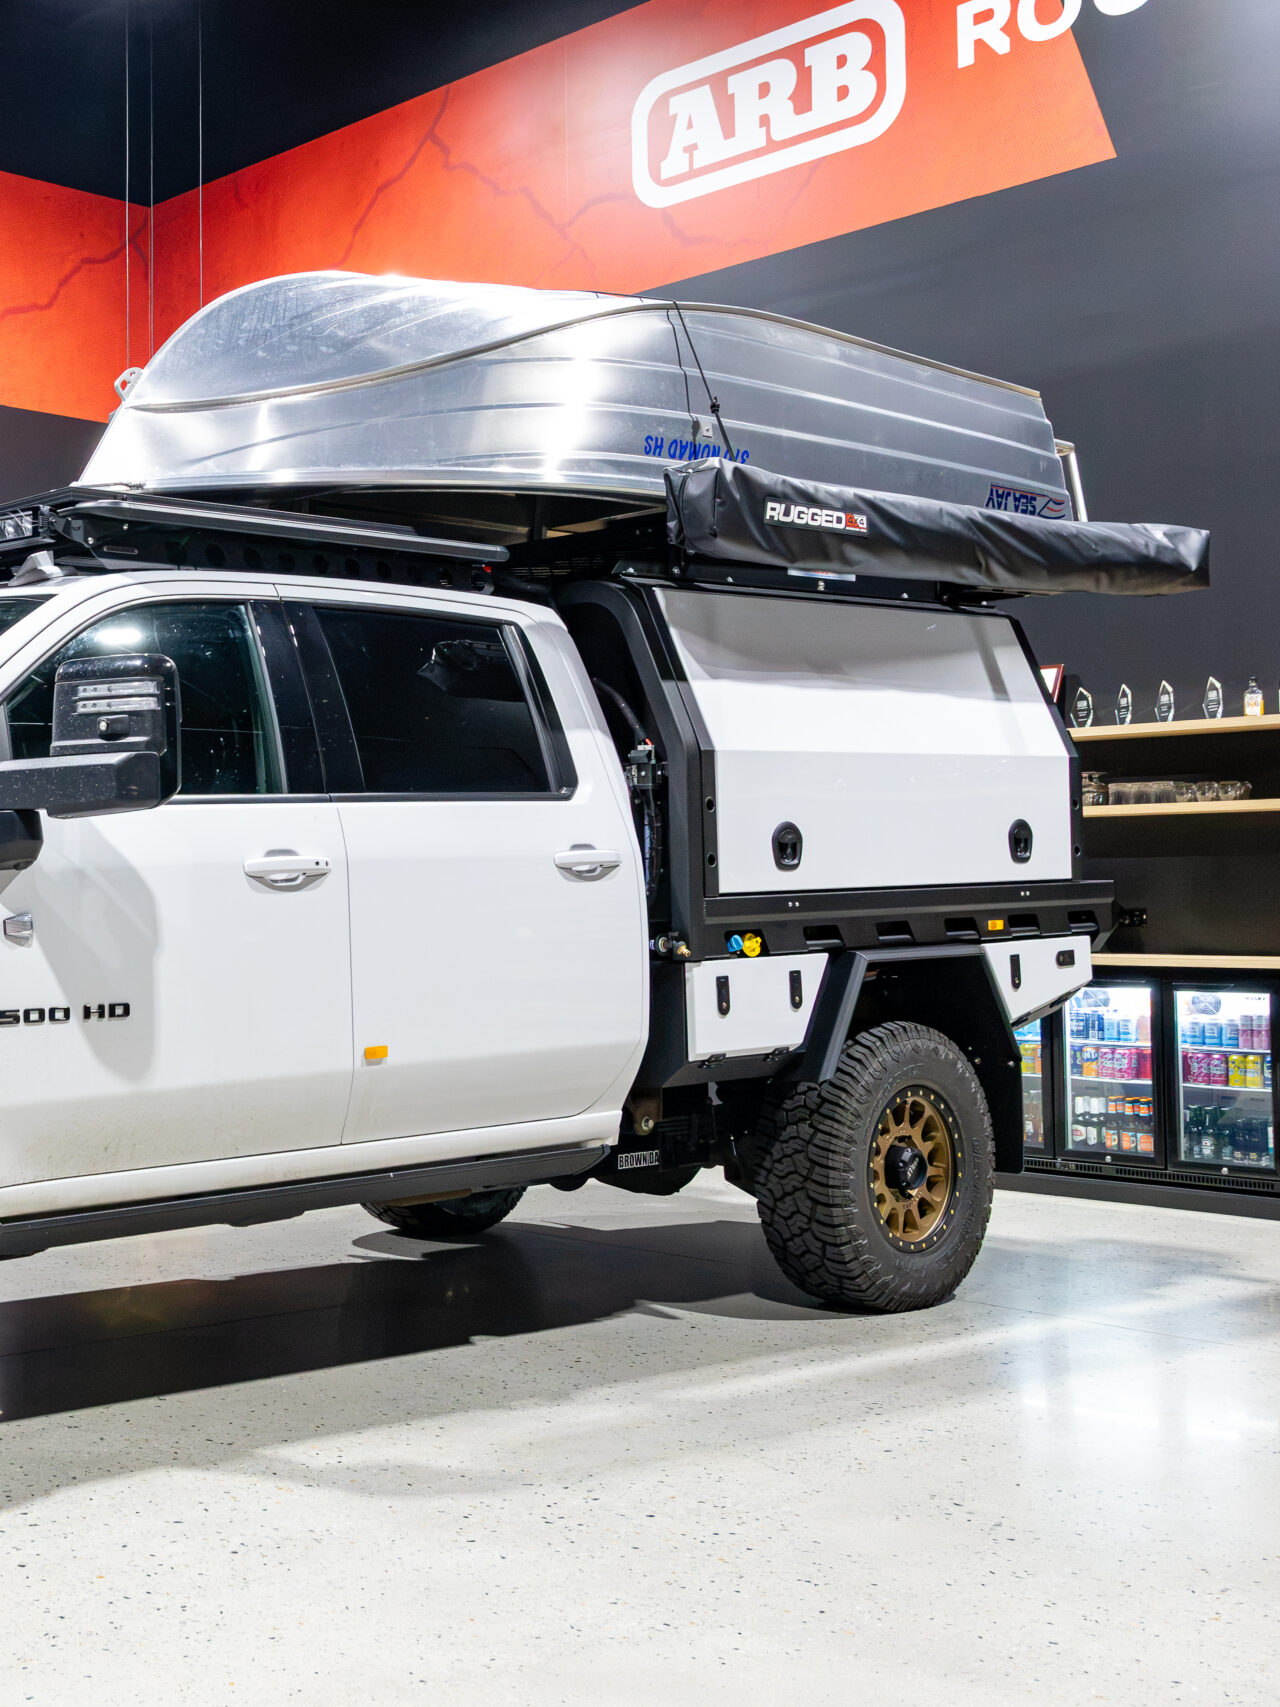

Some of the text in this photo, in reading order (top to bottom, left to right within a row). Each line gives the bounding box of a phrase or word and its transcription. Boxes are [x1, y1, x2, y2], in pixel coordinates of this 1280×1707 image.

[660, 0, 1148, 181] ARB RO
[643, 434, 665, 457] HS
[985, 487, 1037, 516] SEA JAY
[765, 501, 846, 530] RUGGED
[83, 1002, 131, 1022] HD
[618, 1152, 648, 1170] BROWN
